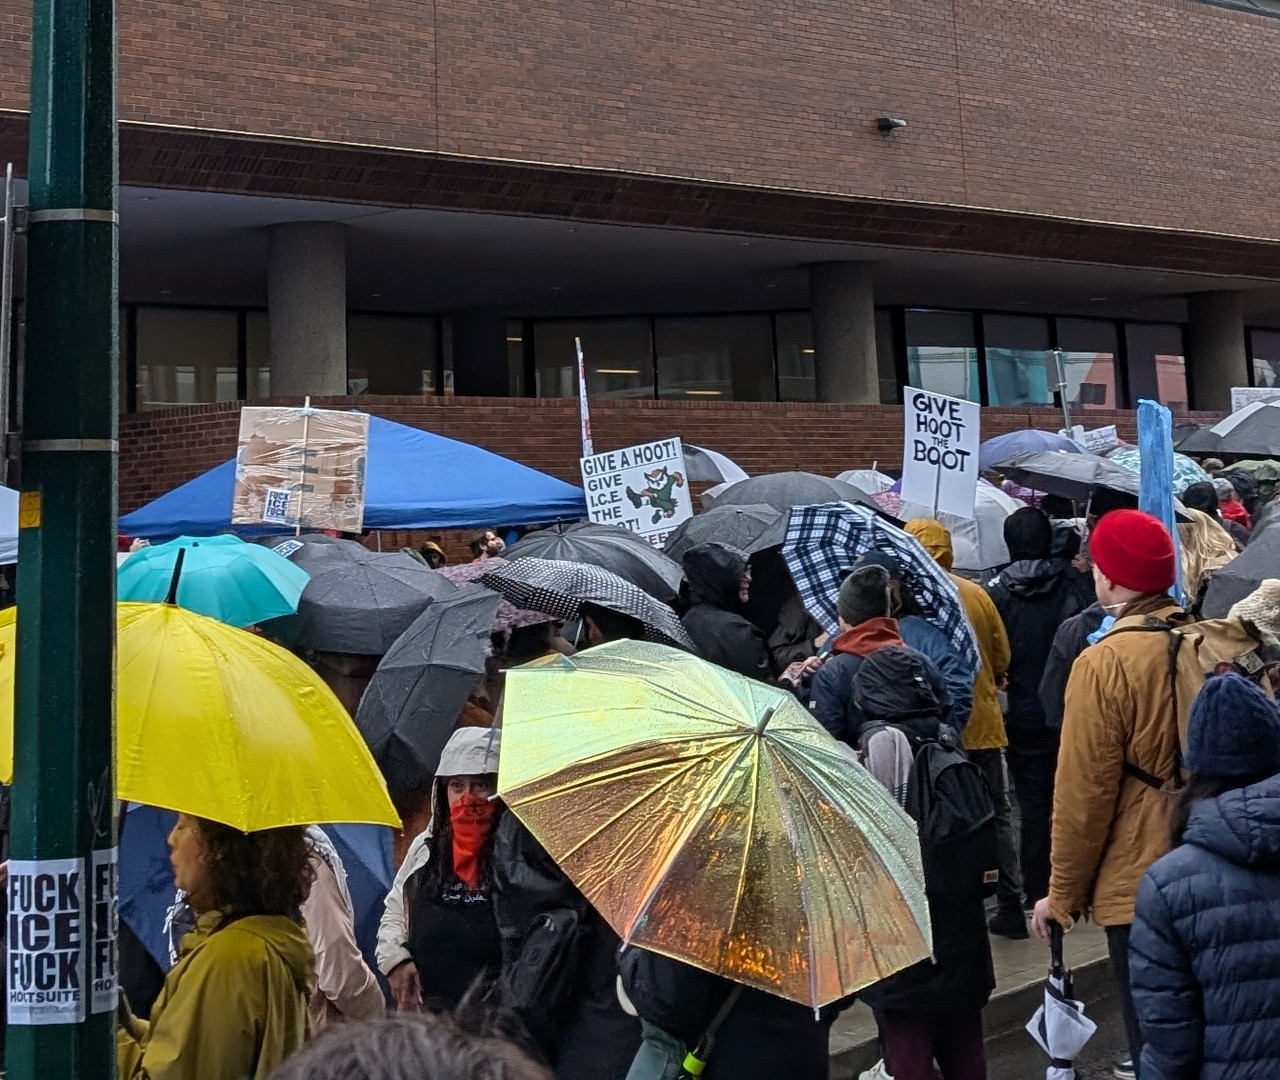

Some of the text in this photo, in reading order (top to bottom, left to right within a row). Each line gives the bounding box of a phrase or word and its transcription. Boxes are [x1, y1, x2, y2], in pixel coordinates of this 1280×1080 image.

[912, 392, 963, 421] GIVE
[915, 413, 966, 442] HOOT
[931, 436, 949, 449] THE
[583, 440, 677, 476] GIVE A HOOT!
[913, 439, 971, 472] BOOT
[588, 473, 624, 492] GIVE
[267, 499, 288, 509] ICE
[269, 490, 289, 500] FUCK
[590, 490, 623, 508] I.C.E.
[265, 508, 286, 517] FUCK
[591, 506, 623, 523] THE
[9, 873, 81, 913] FUCK
[9, 911, 82, 952] ICE
[9, 950, 81, 992] FUCK
